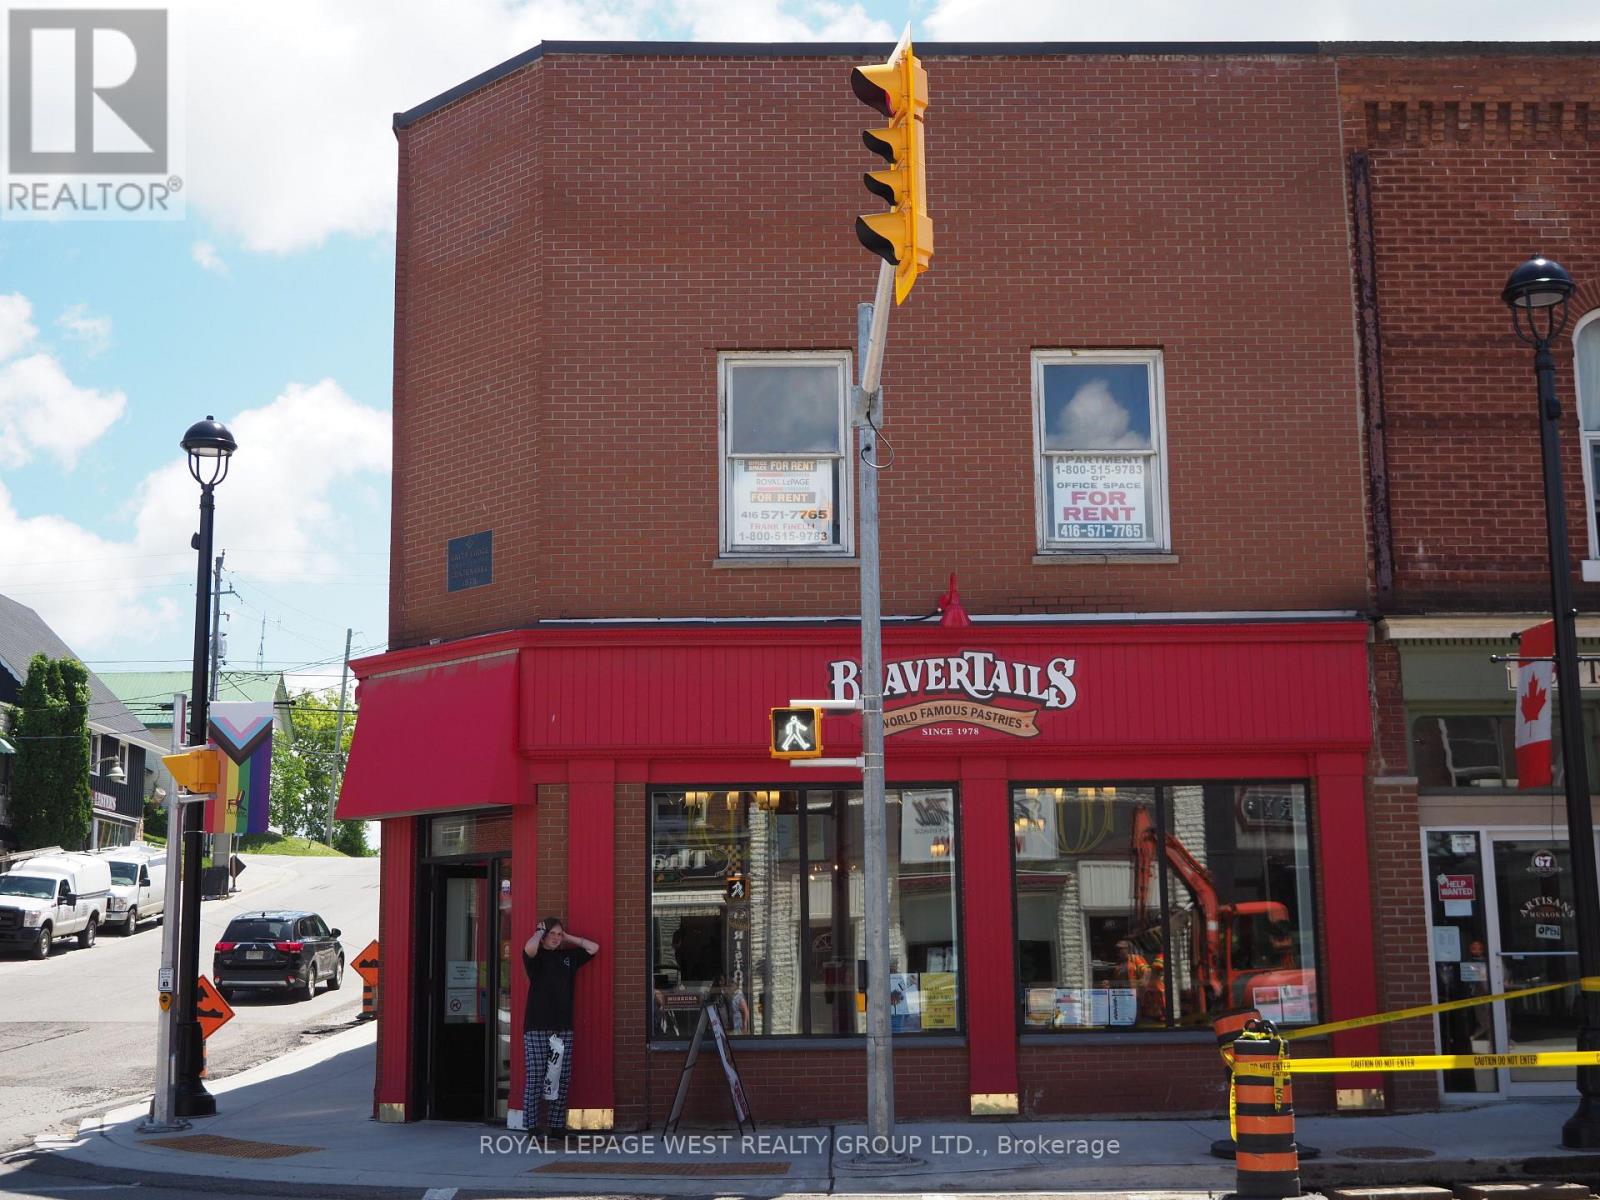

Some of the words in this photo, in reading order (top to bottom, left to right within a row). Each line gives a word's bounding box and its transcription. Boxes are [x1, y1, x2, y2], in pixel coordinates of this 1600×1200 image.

[1056, 456, 1140, 464] APARTMENT
[770, 461, 789, 471] FOR
[791, 461, 815, 471] RENT
[1055, 465, 1143, 475] 1-800-515-9783
[751, 493, 773, 502] FOR
[777, 493, 809, 502] RENT
[1071, 491, 1128, 506] FOR
[741, 511, 759, 519] 416
[760, 510, 828, 520] 571-7765
[1063, 507, 1136, 521] RENT
[750, 523, 779, 531] FRANK
[1060, 524, 1141, 538] 416-571-7765
[739, 531, 828, 541] 1-800-515-9783
[830, 651, 1077, 708] BAVERTAILS
[920, 705, 968, 718] FAMOUS
[970, 707, 1023, 729] PASTRIES
[922, 727, 953, 736] SINCE
[957, 727, 980, 736] 1978
[1534, 855, 1552, 867] 67
[1446, 880, 1467, 888] HELP
[1440, 888, 1473, 896] WANTED
[1538, 926, 1560, 936] OPEN
[1350, 1060, 1374, 1068] CAUTION
[1384, 1059, 1395, 1067] NOT
[1397, 1058, 1415, 1067] ENTER
[1474, 1056, 1497, 1066] CAUTION
[1498, 1056, 1506, 1065] DO
[1507, 1056, 1518, 1065] NOT
[1519, 1055, 1538, 1065] ENTER
